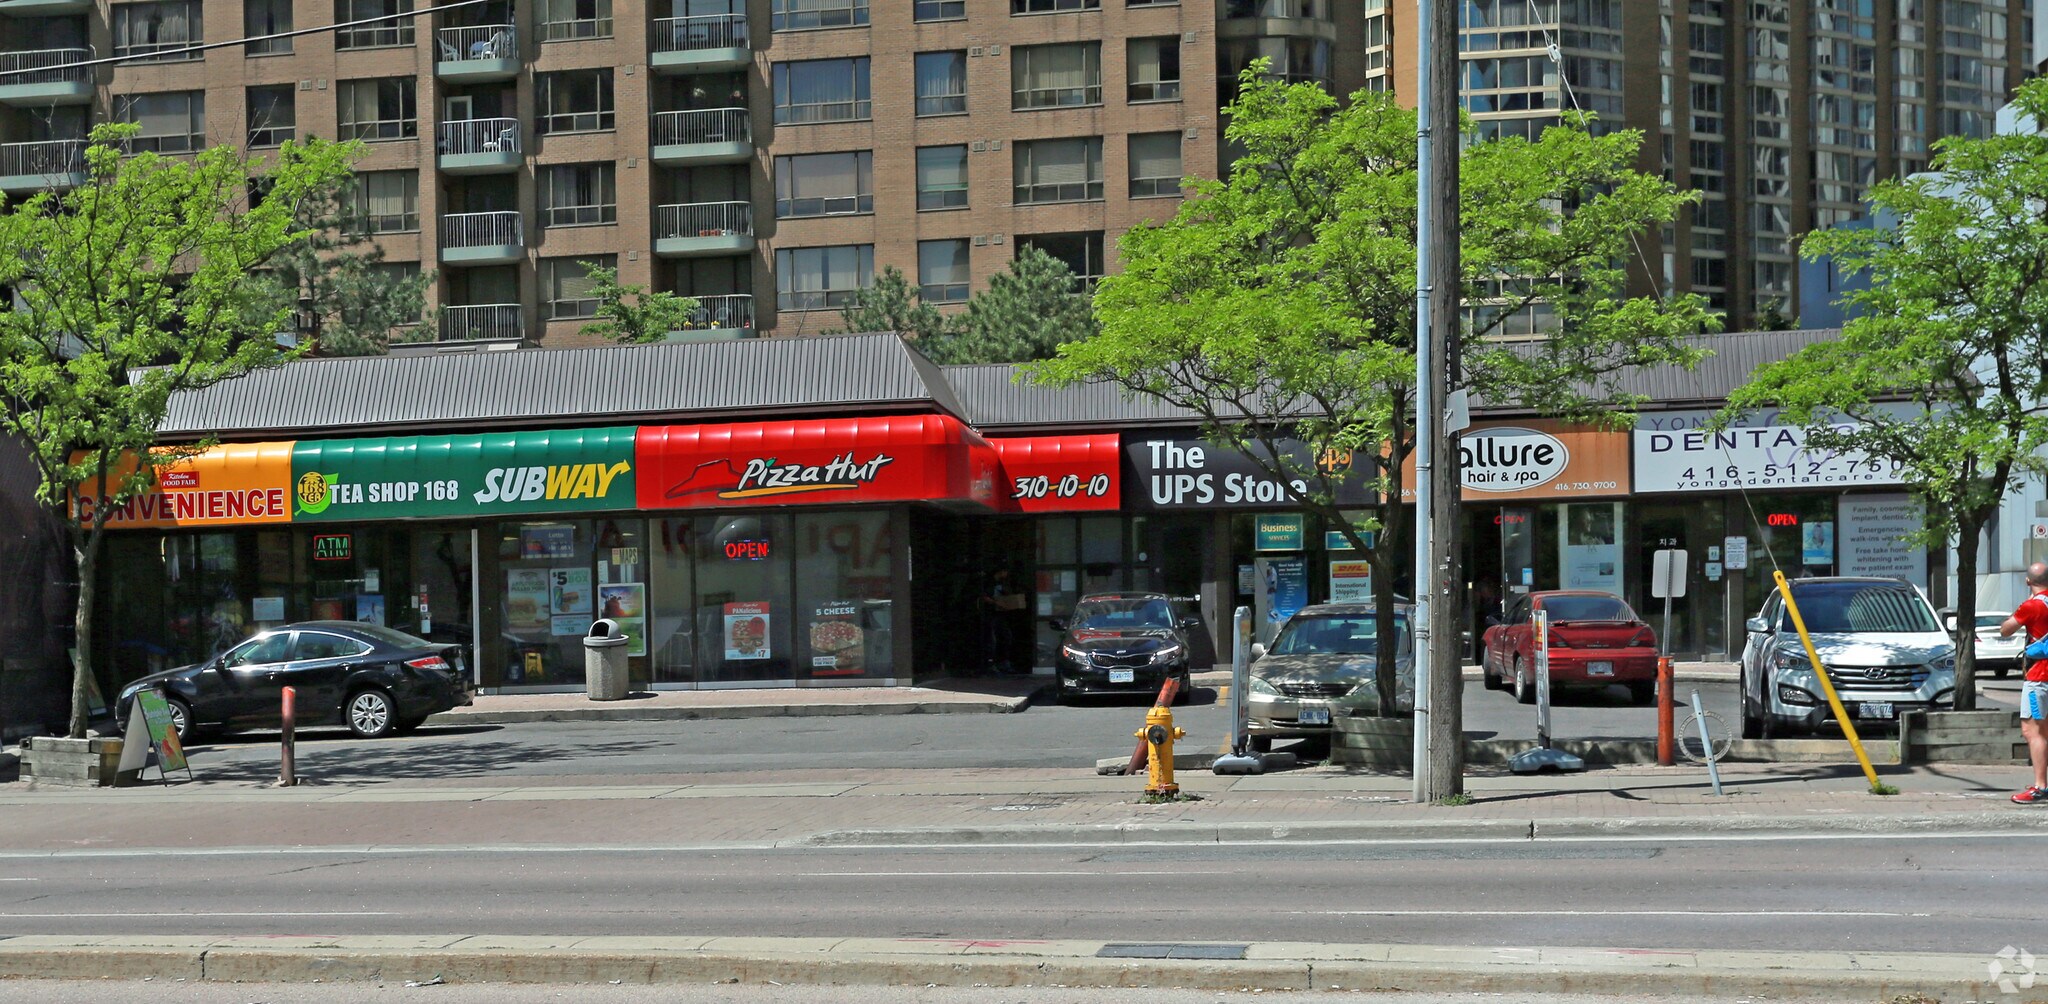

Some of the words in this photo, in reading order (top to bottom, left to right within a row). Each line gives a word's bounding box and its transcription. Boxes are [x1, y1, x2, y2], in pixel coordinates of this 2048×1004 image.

[1651, 416, 1748, 431] YONE
[1147, 441, 1204, 468] The
[1461, 437, 1554, 468] allure
[737, 456, 819, 491] Pizza
[825, 452, 894, 482] Hut
[1468, 471, 1496, 483] hair
[1501, 472, 1509, 482] &
[1514, 470, 1539, 485] spa
[473, 459, 631, 506] SUBWAY
[1013, 473, 1110, 499] 310-10-10
[1152, 474, 1214, 504] UPS
[1593, 481, 1617, 489] 9700
[302, 492, 322, 502] TEA
[329, 483, 363, 504] TEA
[369, 481, 420, 502] SHOP
[424, 480, 459, 500] 168
[1494, 515, 1526, 525] OPEN
[1768, 514, 1797, 526] OPEN
[1261, 524, 1297, 533] Business
[316, 537, 348, 558] ATM
[620, 547, 638, 564] MAPS
[725, 542, 769, 559] OPEN
[1857, 556, 1892, 564] whitening
[1868, 564, 1893, 572] patient
[824, 607, 855, 615] CHEESE
